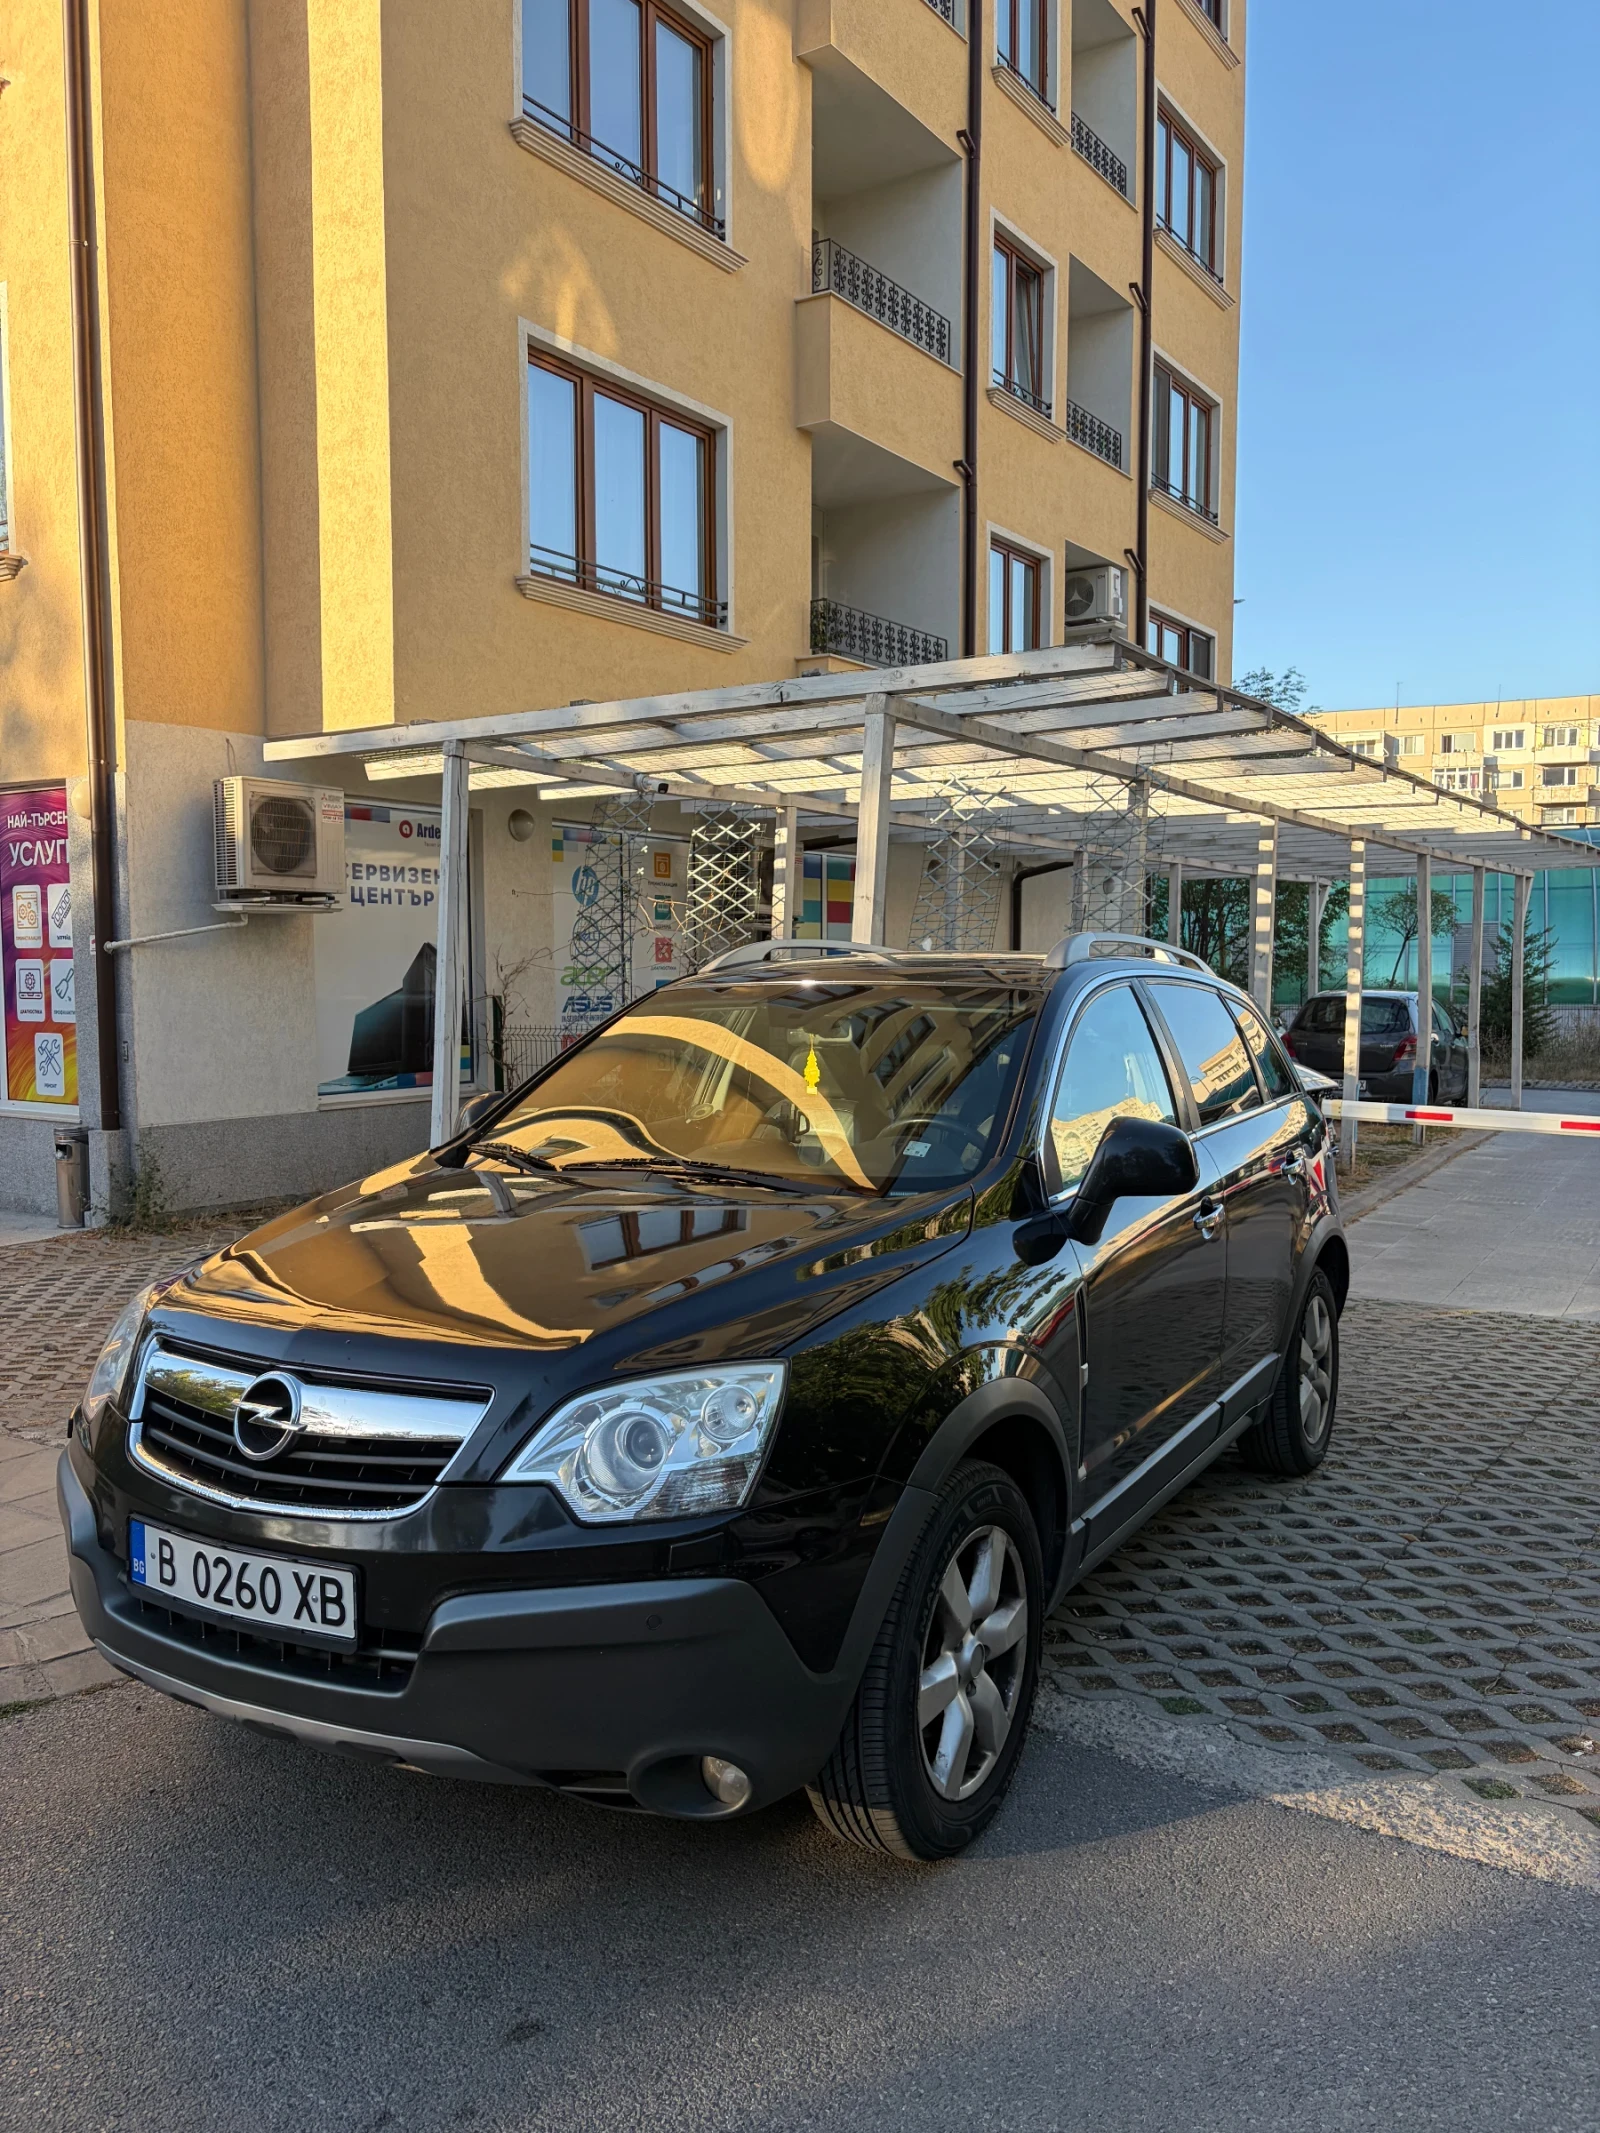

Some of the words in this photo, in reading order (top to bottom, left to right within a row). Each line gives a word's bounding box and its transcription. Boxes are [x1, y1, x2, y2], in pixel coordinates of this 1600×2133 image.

[345, 862, 440, 885] ЕРВИЗЕ
[350, 886, 434, 907] ЦЕНТЪР
[575, 866, 595, 907] hp
[562, 996, 613, 1013] ASUS
[132, 1557, 145, 1575] BG
[158, 1537, 176, 1586] B
[192, 1550, 281, 1615] 0260
[292, 1570, 346, 1627] XB
